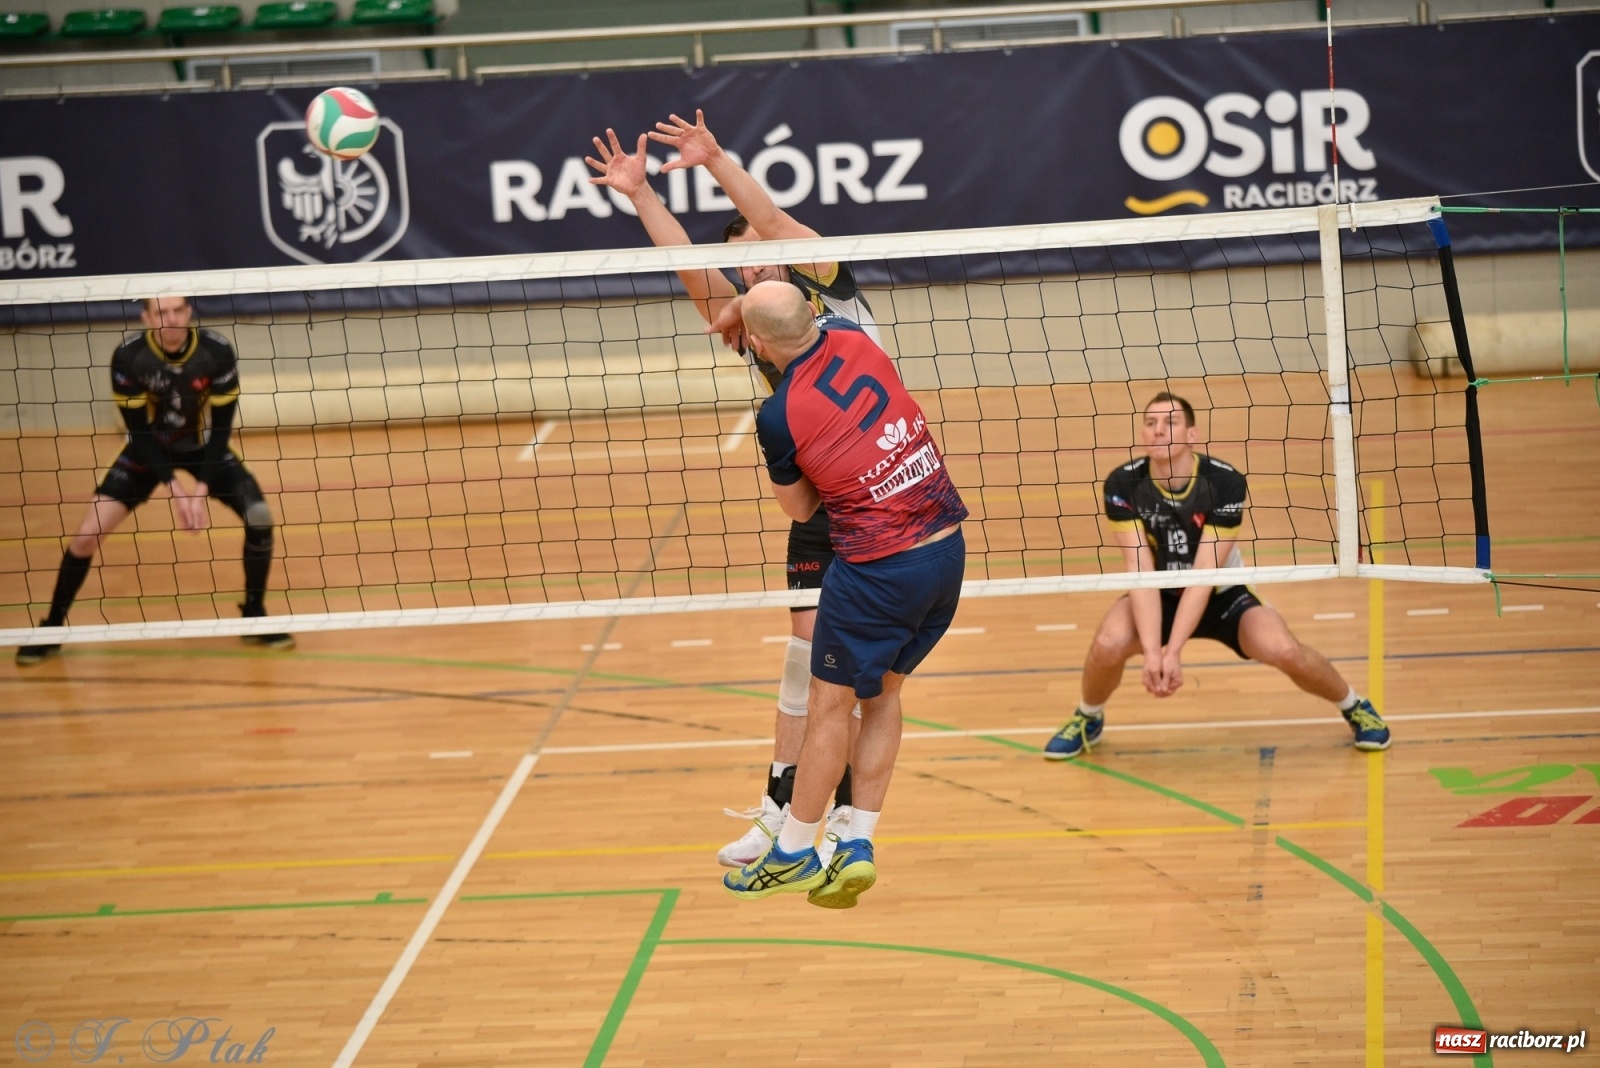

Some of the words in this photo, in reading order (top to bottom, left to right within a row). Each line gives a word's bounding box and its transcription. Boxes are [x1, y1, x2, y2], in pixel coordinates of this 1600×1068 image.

[1119, 89, 1377, 182] OSiR
[1223, 173, 1379, 209] RACIBÓRZ
[813, 355, 890, 433] 5
